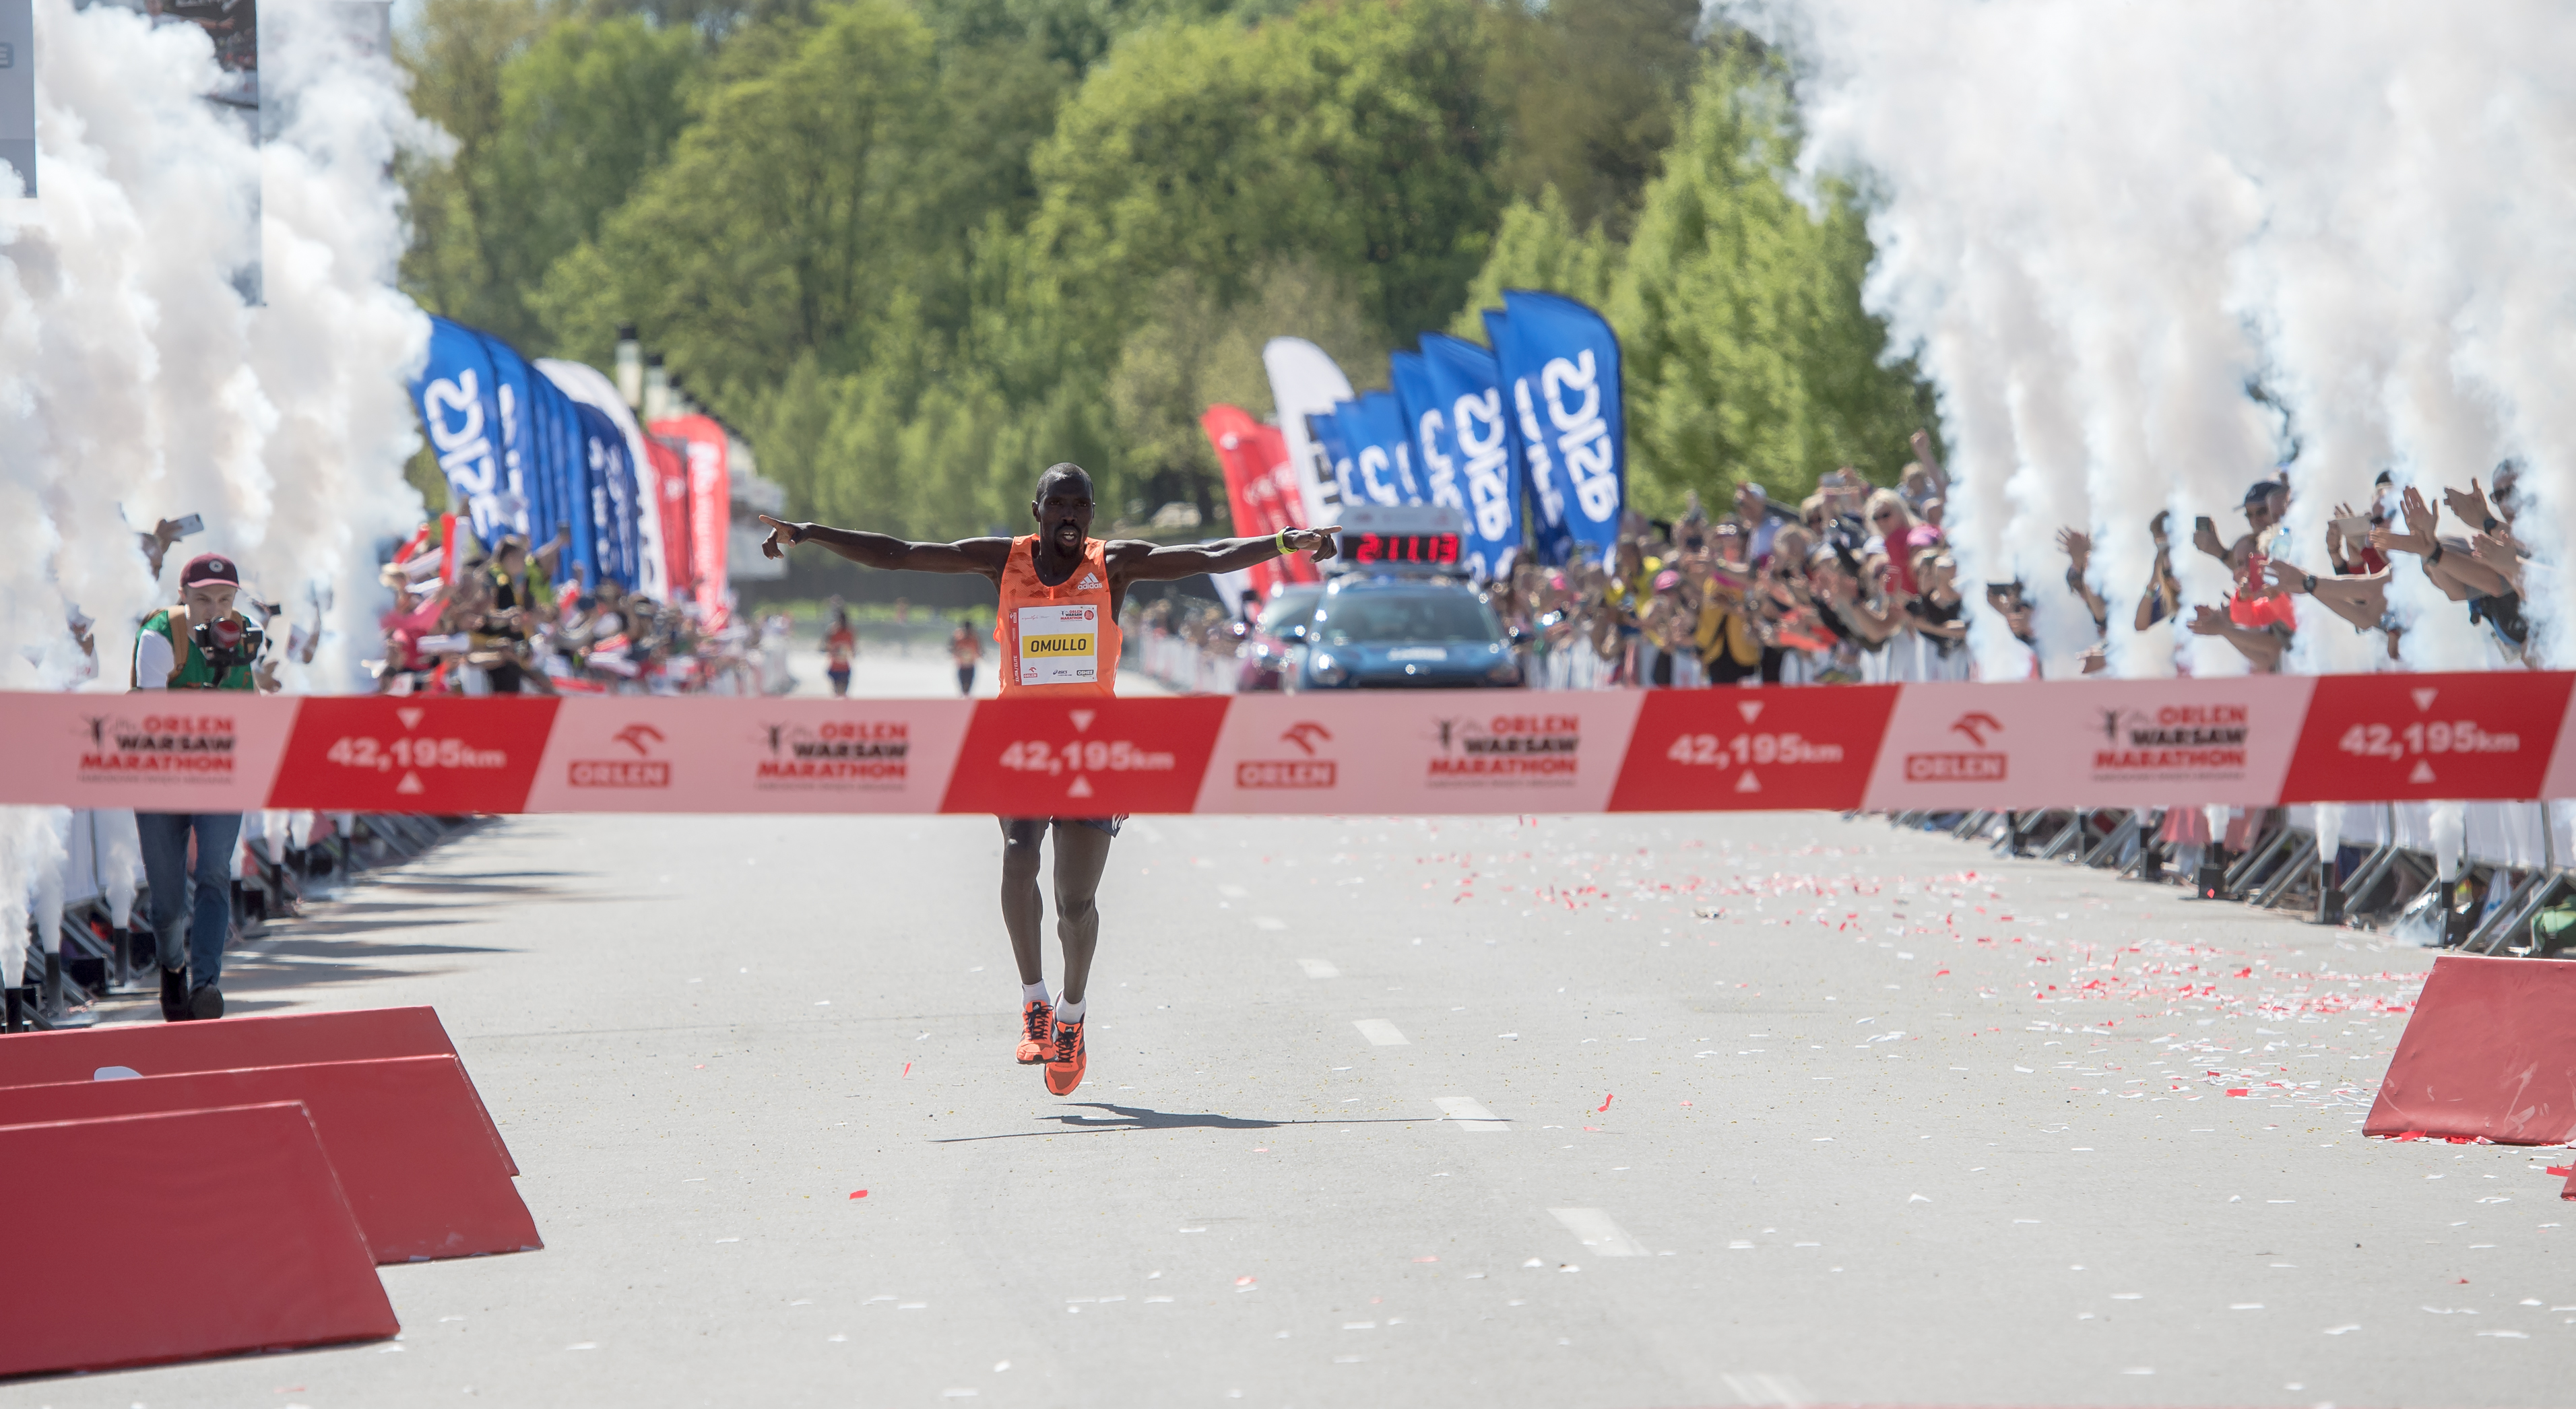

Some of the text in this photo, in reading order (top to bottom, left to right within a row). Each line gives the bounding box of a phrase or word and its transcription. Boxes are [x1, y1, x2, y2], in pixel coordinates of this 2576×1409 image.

[1031, 638, 1087, 653] OMULLO
[142, 715, 234, 733] ORLEN
[1490, 714, 1579, 733] ORLEN
[2158, 704, 2249, 725] ORLEN
[819, 720, 908, 740] ORLEN
[2129, 727, 2249, 747] WARSAW
[115, 733, 236, 752] WARSAW
[792, 741, 909, 760] WARSAW
[1463, 736, 1580, 756] WARSAW
[79, 752, 233, 772] MARATHON
[1427, 757, 1578, 776] MARATHON
[1910, 758, 2000, 777] ORLEN
[2092, 749, 2247, 770] MARATHON
[573, 764, 664, 784] ORLEN
[756, 761, 907, 779] MARATHON
[1241, 764, 1330, 784] ORLEN
